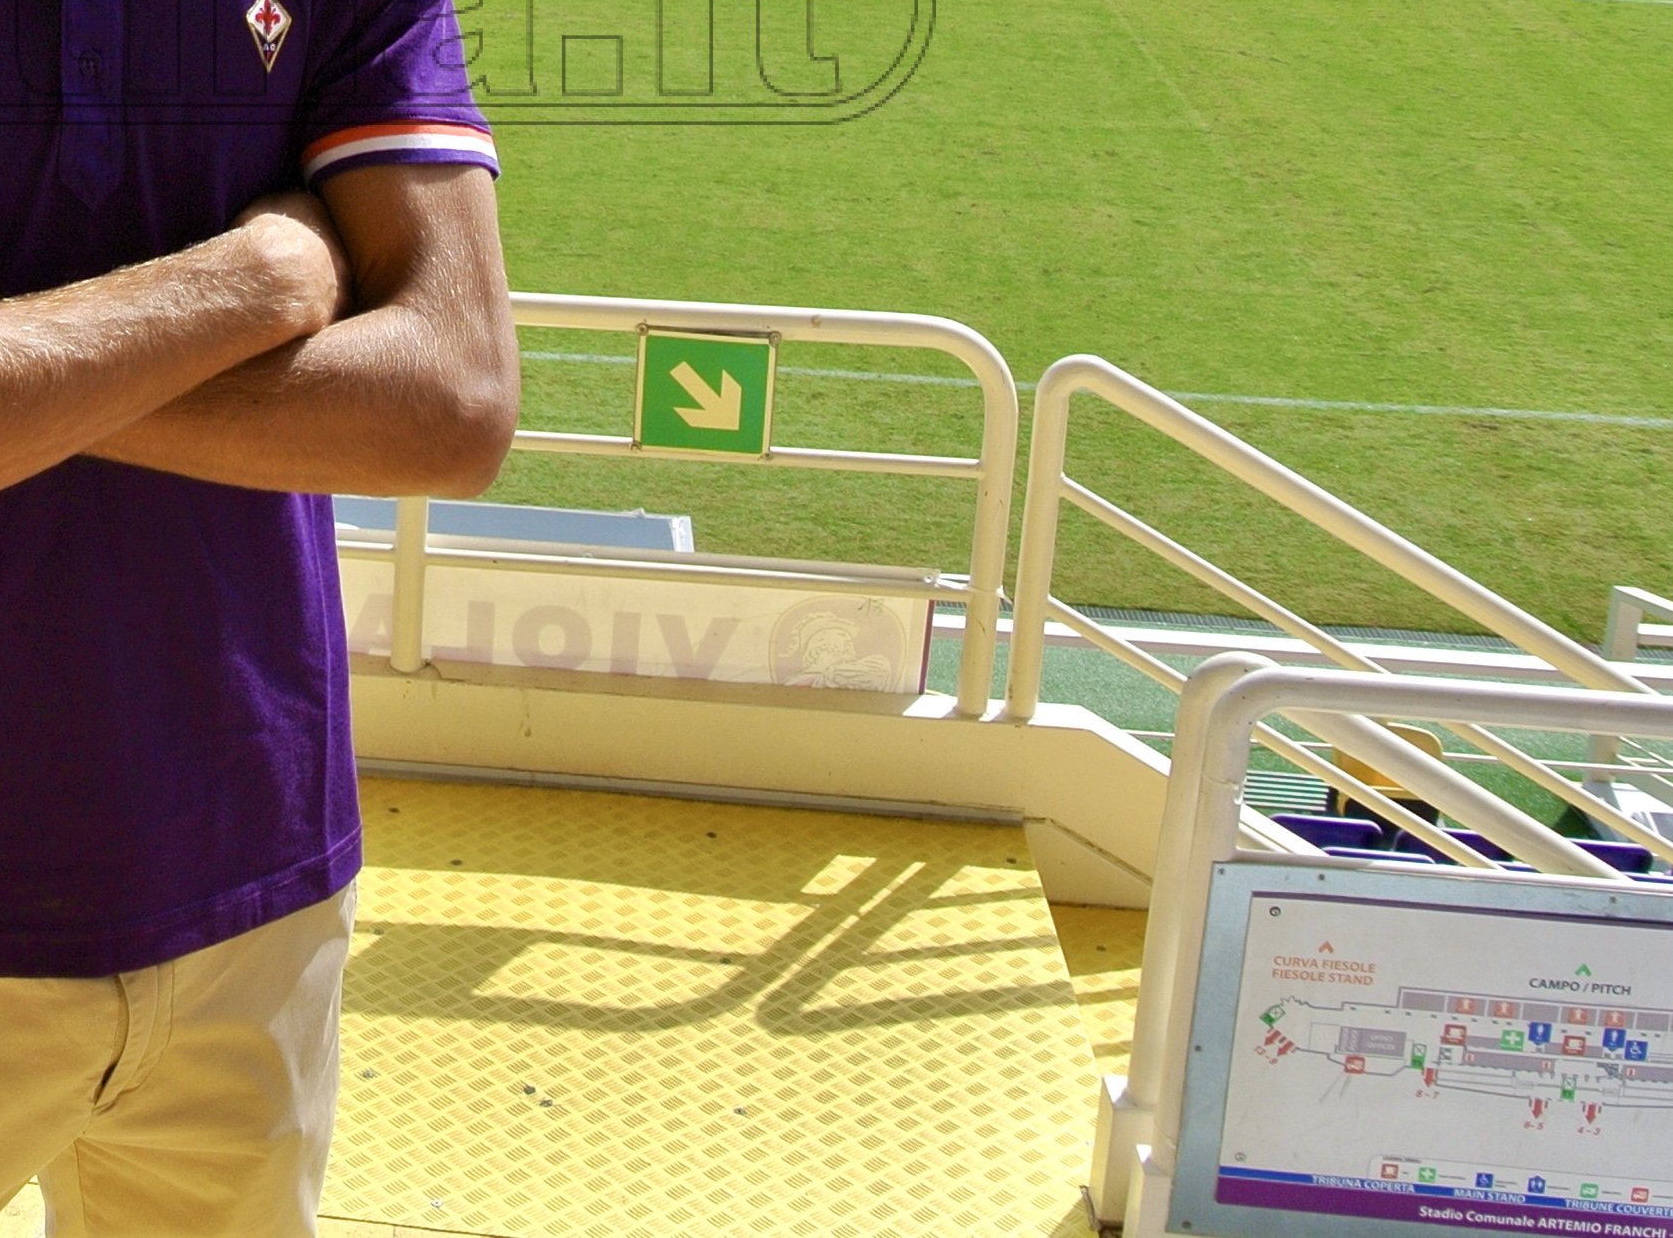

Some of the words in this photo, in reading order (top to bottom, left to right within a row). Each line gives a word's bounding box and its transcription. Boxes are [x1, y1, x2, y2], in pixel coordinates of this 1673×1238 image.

[1273, 956, 1318, 969] CURVA
[1322, 959, 1376, 973] FIESOLE
[1272, 968, 1325, 982] FIESOLE
[1328, 973, 1373, 986] STAND
[1529, 978, 1580, 992] CAMPO
[1591, 983, 1631, 995] PITCH
[1312, 1175, 1362, 1189] TRIBUNA
[1363, 1180, 1415, 1193] COPERTA
[1454, 1188, 1482, 1199] MAIN
[1487, 1192, 1526, 1203] STAND
[1565, 1199, 1614, 1211] TRIBUNE
[1419, 1206, 1463, 1220] Stadio
[1465, 1210, 1535, 1228] Comunale
[1537, 1217, 1602, 1233] ARTEMIO
[1604, 1222, 1667, 1238] FRANCHI
